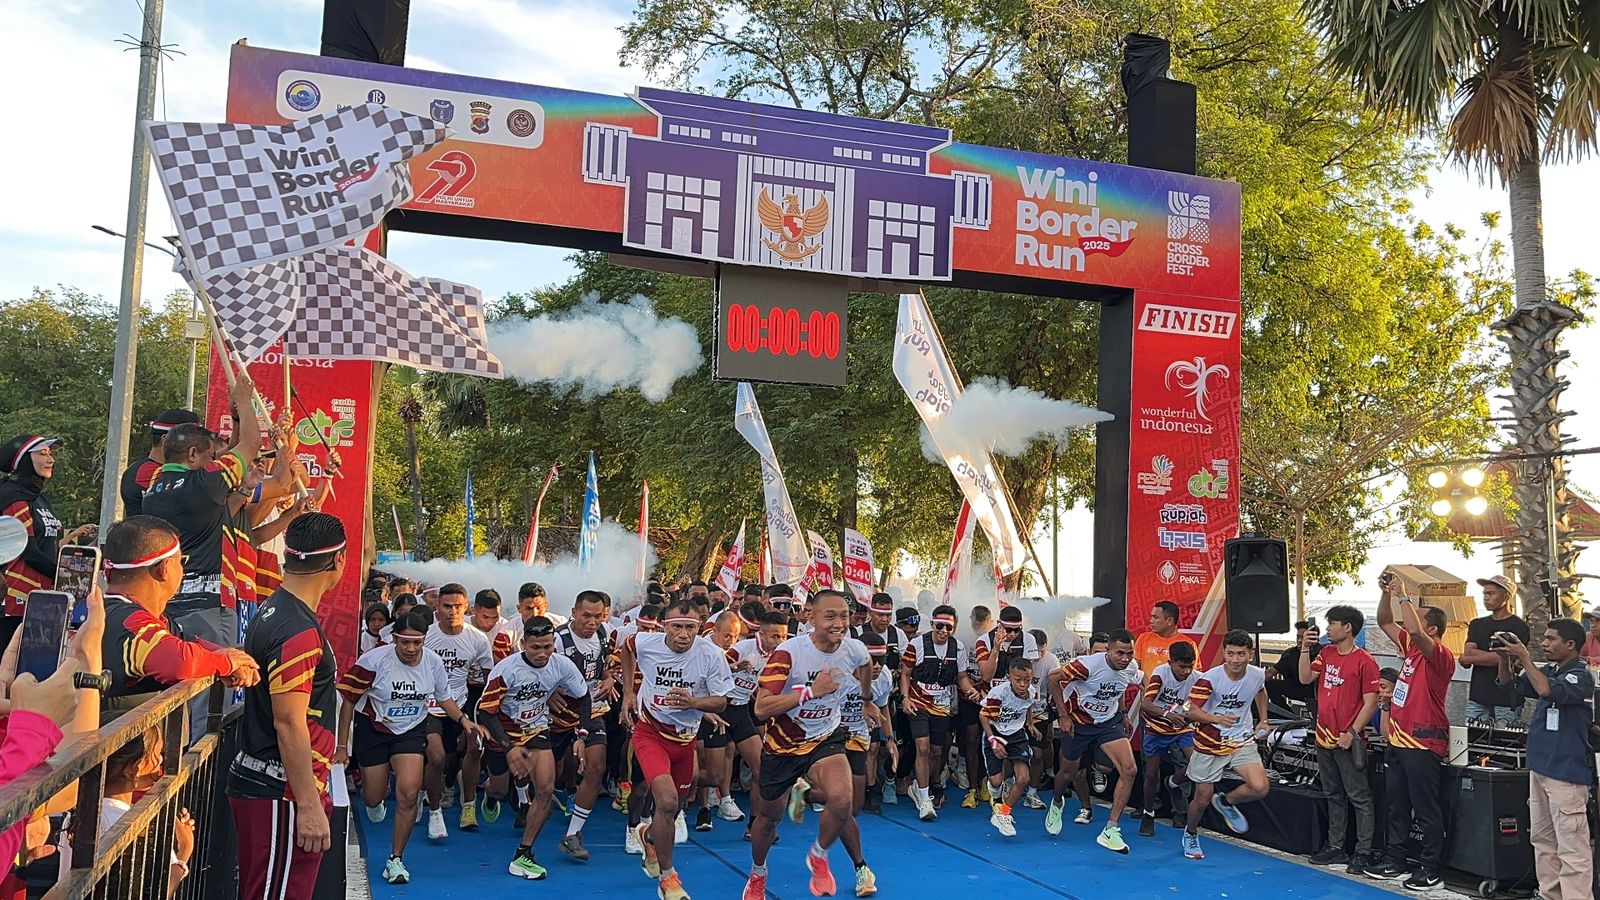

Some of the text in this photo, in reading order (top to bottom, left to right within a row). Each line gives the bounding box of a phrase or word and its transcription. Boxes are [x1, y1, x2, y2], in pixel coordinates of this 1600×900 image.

[263, 136, 341, 171] Wini
[271, 151, 380, 195] Border
[339, 175, 363, 190] 2025
[1016, 166, 1099, 207] Wini
[280, 189, 346, 219] Run
[1016, 199, 1138, 242] Border
[1015, 234, 1086, 272] Run
[1082, 240, 1111, 251] 2025
[1167, 241, 1203, 256] CROSS
[1167, 253, 1210, 268] BORDER
[1166, 264, 1194, 277] FEST.
[1144, 307, 1231, 335] FINISH
[727, 303, 841, 361] 00:00:00
[1140, 406, 1197, 420] wonderful
[1140, 417, 1214, 435] indonesia
[1160, 510, 1207, 523] Rupiah
[1159, 529, 1206, 551] QRIS
[845, 565, 871, 582] 0:40
[1179, 575, 1200, 585] PeKA
[442, 657, 468, 668] order
[656, 666, 683, 678] Wini
[391, 680, 416, 691] Wini
[655, 676, 696, 689] Border
[391, 691, 428, 701] Border
[391, 707, 416, 716] 7252
[803, 710, 829, 718] 7783
